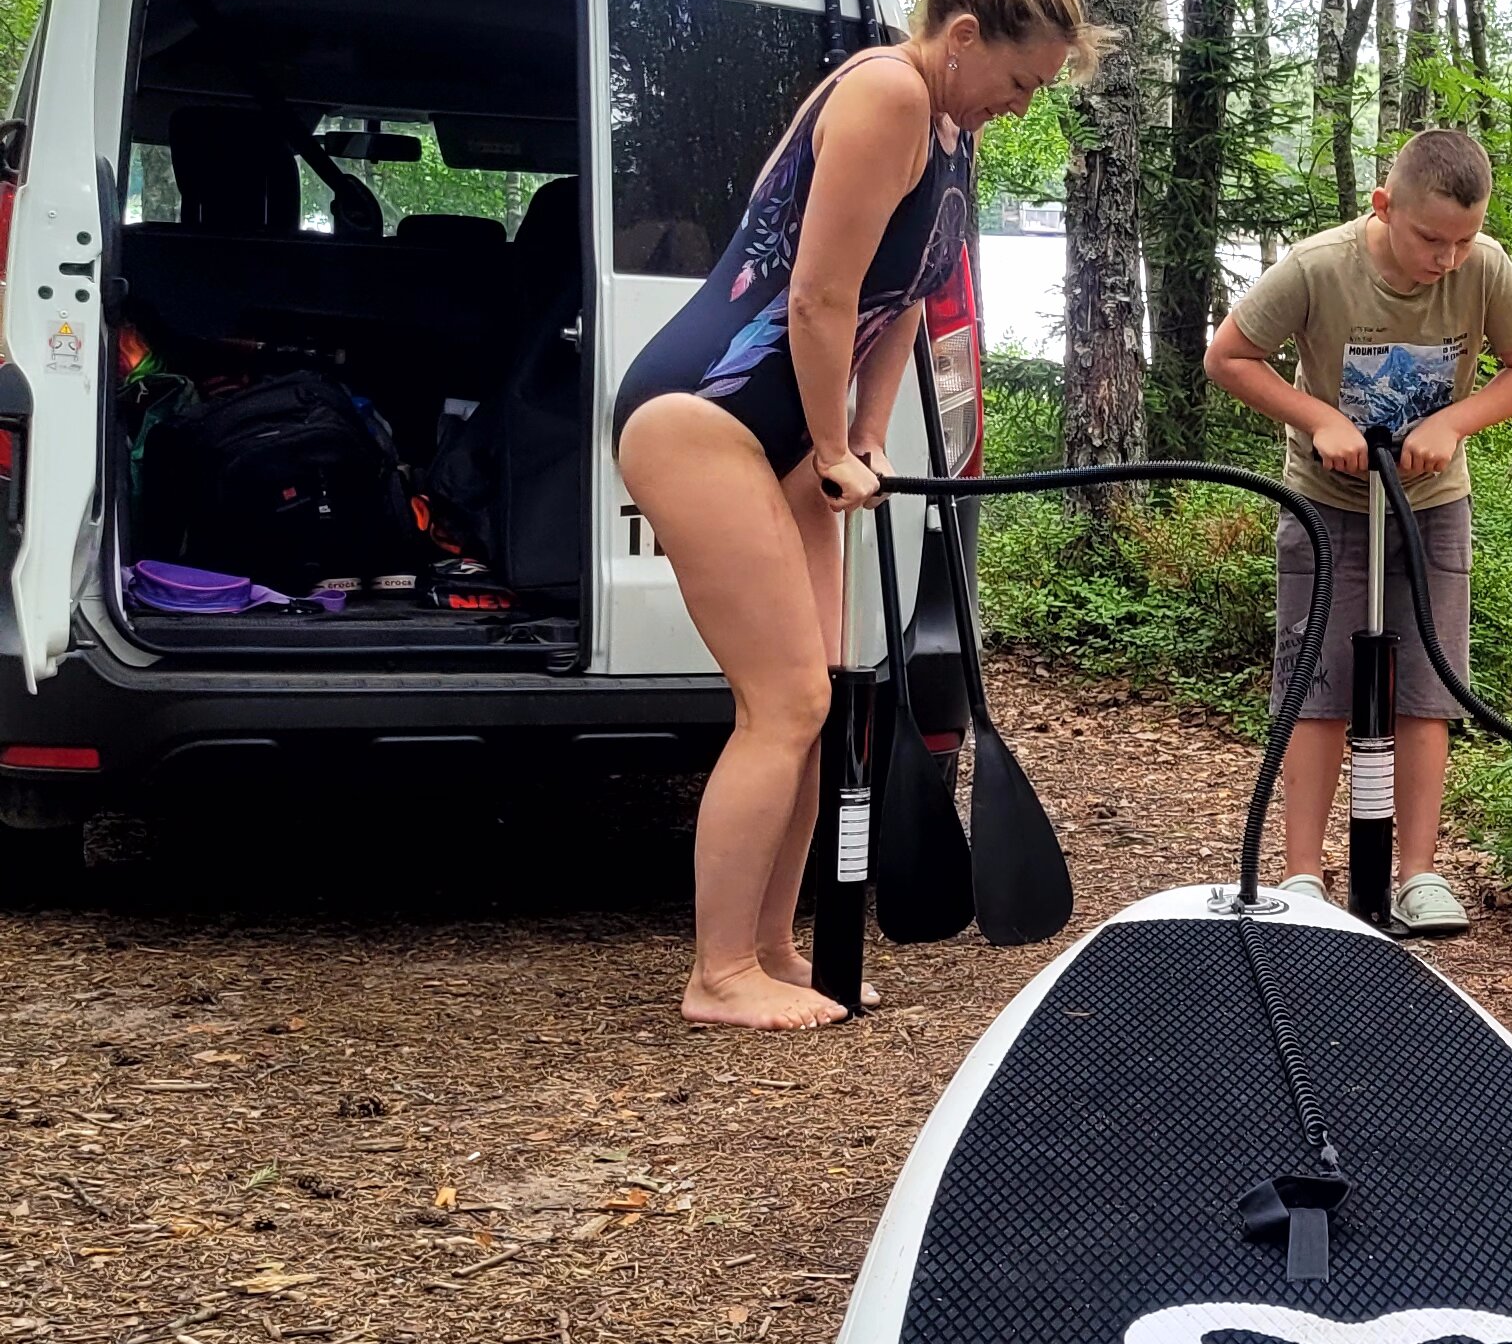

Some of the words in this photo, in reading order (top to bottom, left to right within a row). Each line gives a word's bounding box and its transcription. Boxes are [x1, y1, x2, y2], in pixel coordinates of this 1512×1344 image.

[1348, 345, 1390, 357] MOUNTAIN
[327, 581, 356, 589] crocs
[384, 579, 412, 587] crocs
